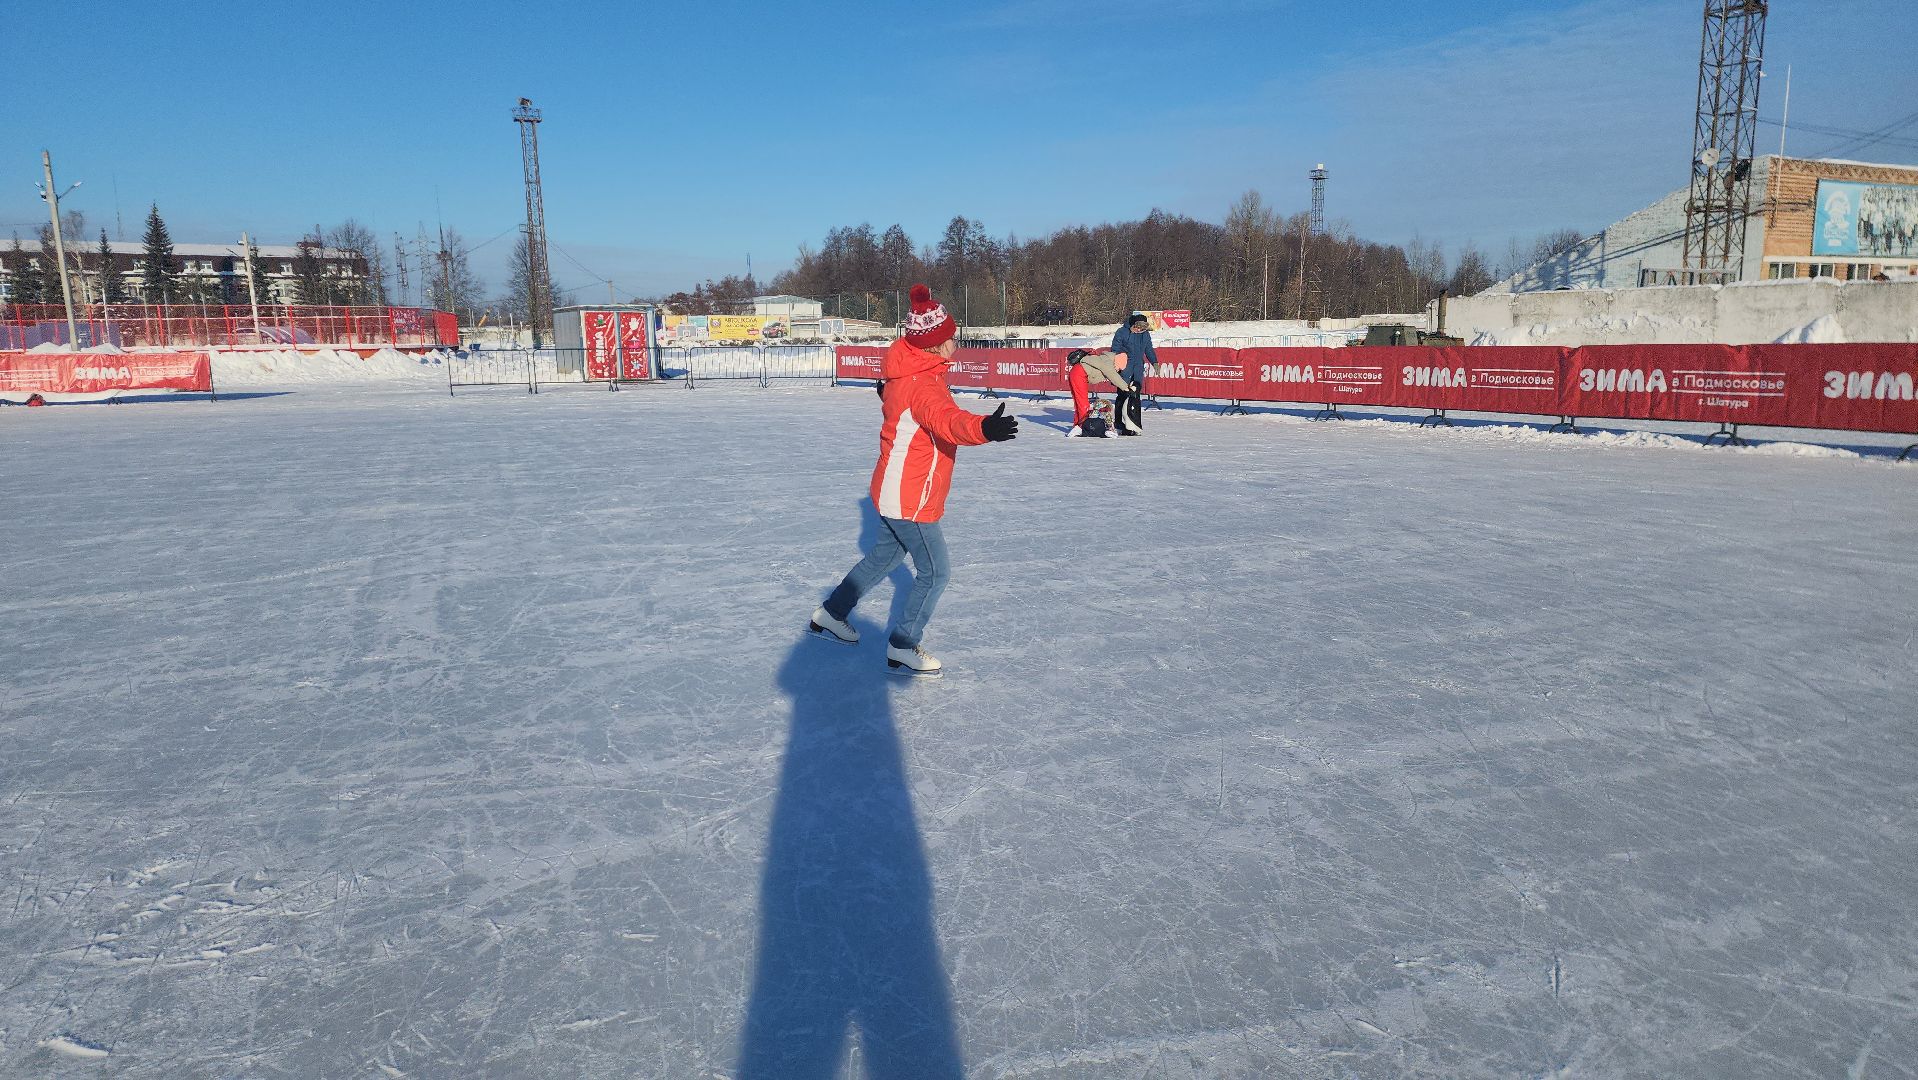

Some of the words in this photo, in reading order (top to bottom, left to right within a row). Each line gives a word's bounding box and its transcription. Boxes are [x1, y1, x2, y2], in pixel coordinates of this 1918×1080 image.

[75, 366, 131, 380] ЗИМА
[997, 362, 1026, 376] ЗИМА
[1195, 367, 1243, 377] Подмосковье
[1260, 364, 1315, 383] ЗИМА
[1325, 370, 1382, 380] Подмосковье
[1402, 366, 1467, 388] ЗИМА
[1480, 373, 1555, 385] Подмосковье
[1579, 368, 1668, 393] ЗИМА
[1672, 378, 1680, 387] в
[1684, 374, 1785, 390] Подмосковье
[1823, 370, 1918, 401] ЗИМ
[1707, 397, 1749, 409] Шатура
